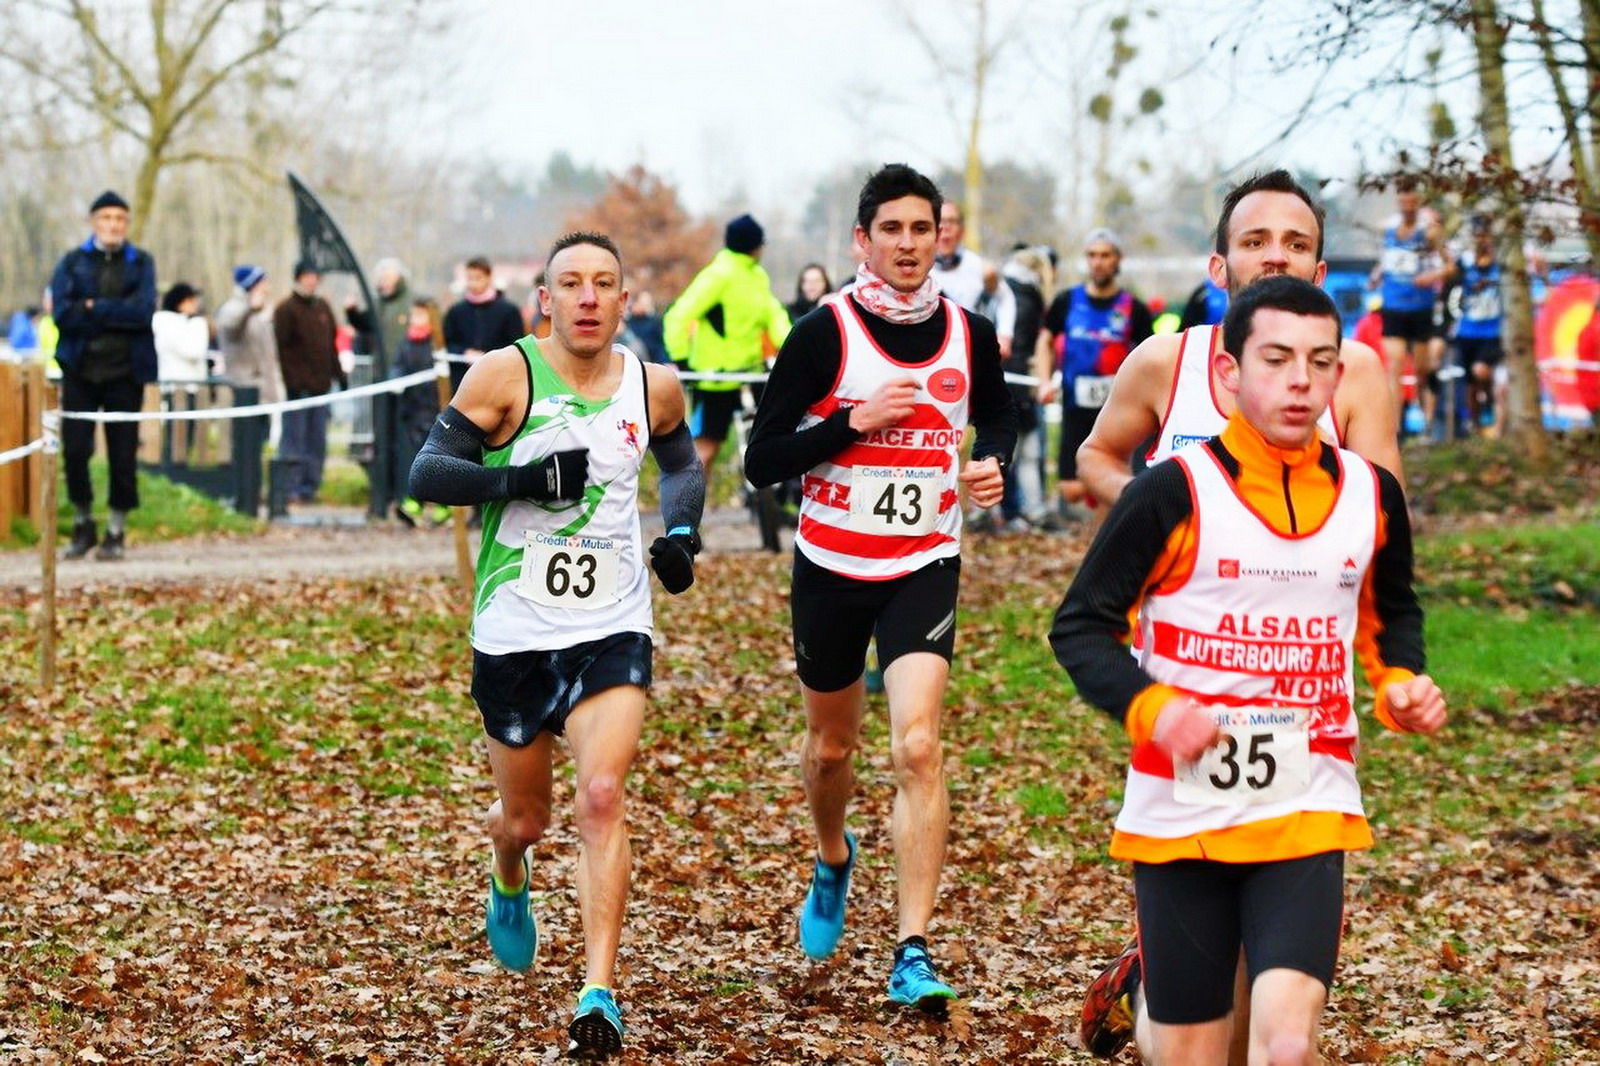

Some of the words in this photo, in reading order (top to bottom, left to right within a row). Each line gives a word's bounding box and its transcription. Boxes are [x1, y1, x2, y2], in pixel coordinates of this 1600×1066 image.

[862, 467, 892, 478] Crédit
[905, 469, 936, 479] Mutuel
[873, 483, 922, 526] 43
[535, 533, 568, 548] Crédit
[581, 539, 614, 550] Mutuel
[545, 551, 598, 599] 63
[1216, 613, 1338, 639] ALSACE
[1177, 631, 1313, 673] LAUTERBOURG
[1249, 712, 1295, 726] Mutuel
[1208, 733, 1277, 791] 35
